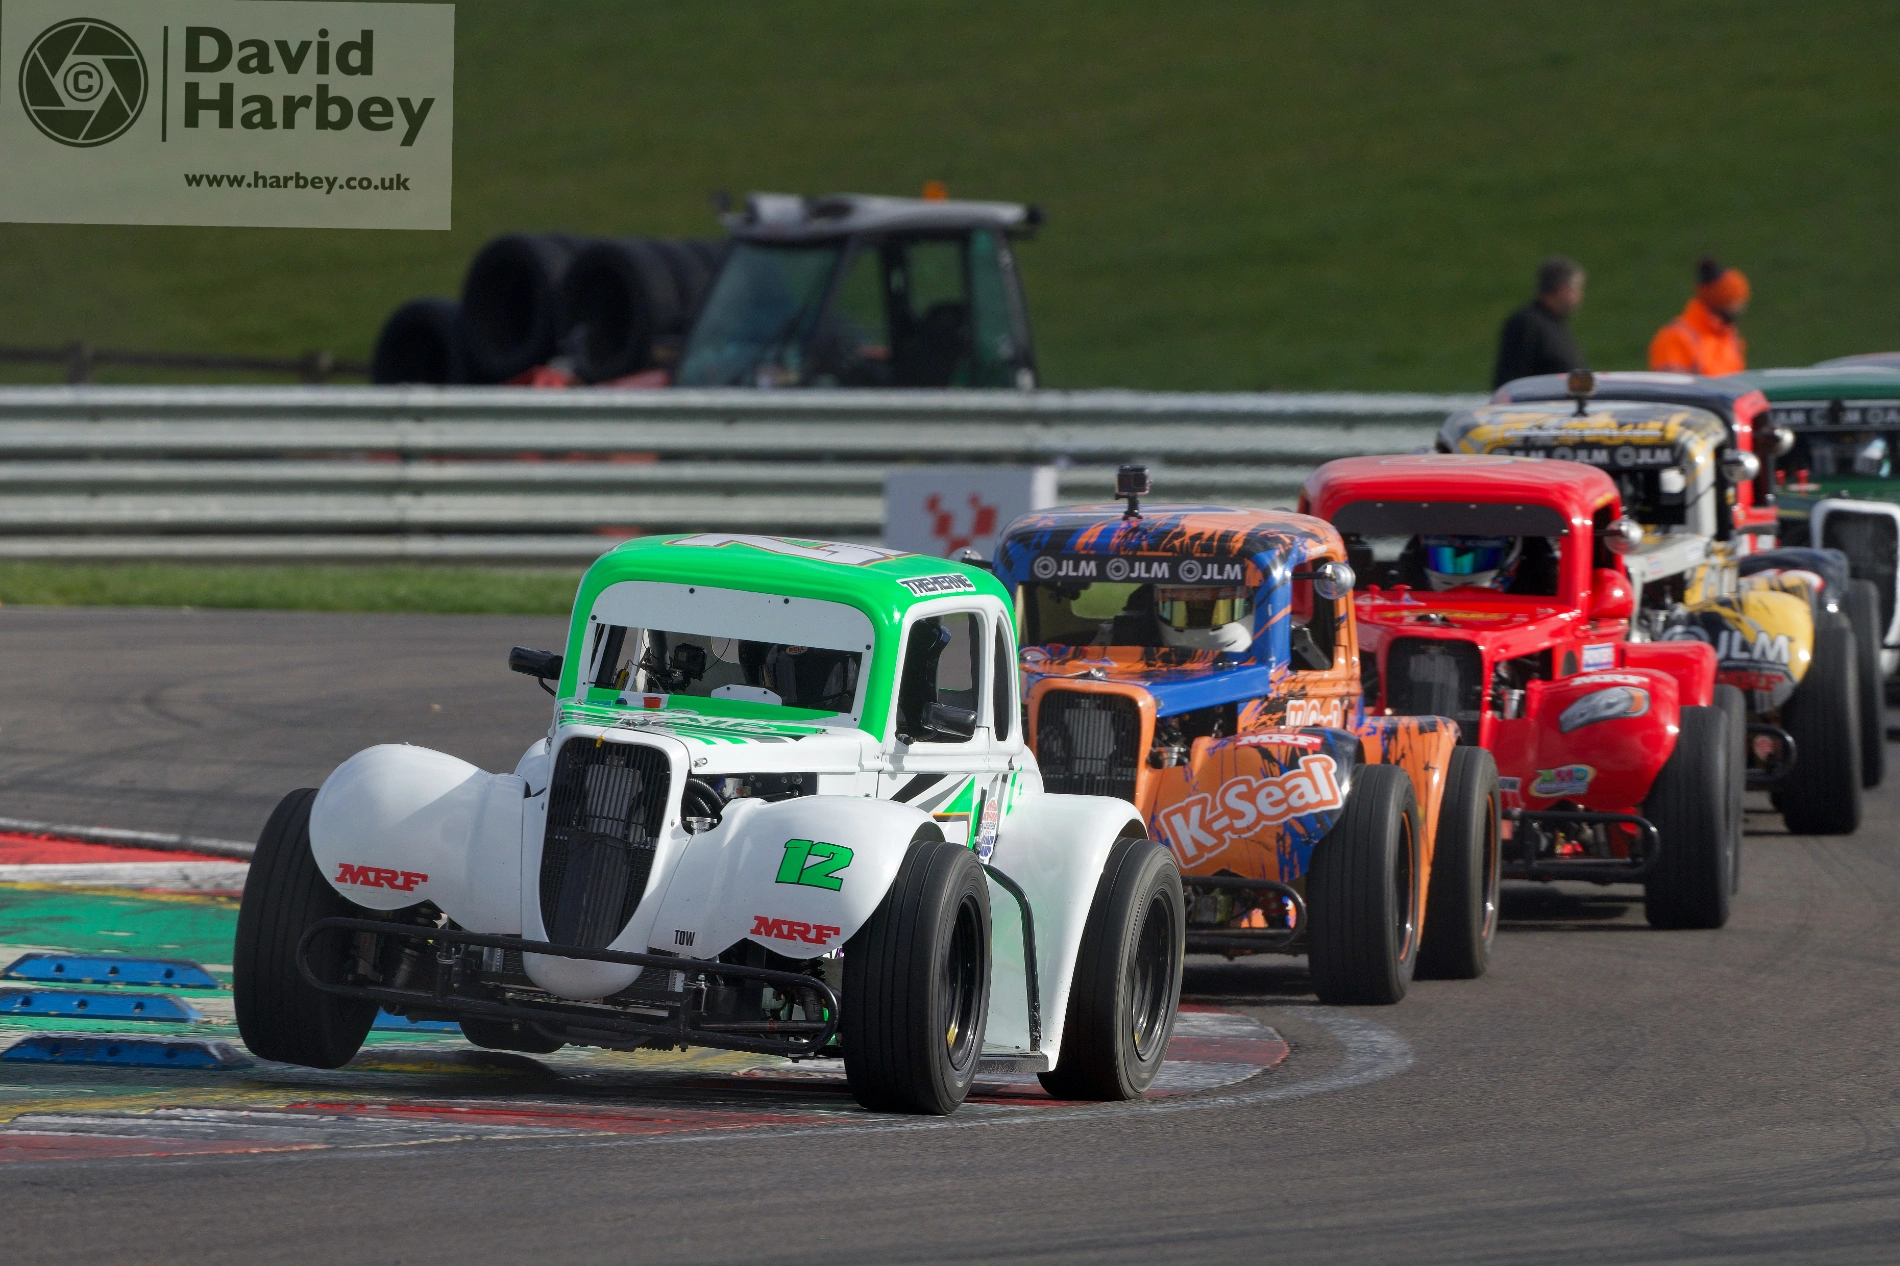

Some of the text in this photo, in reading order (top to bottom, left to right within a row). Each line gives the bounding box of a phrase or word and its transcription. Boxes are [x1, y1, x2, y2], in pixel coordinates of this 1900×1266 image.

[1636, 448, 1672, 464] JLM
[1057, 560, 1242, 580] JLM JLM JLM
[1717, 630, 1789, 664] JLM
[1237, 733, 1321, 747] MRF
[775, 838, 854, 892] 12
[334, 863, 428, 892] MRF
[674, 929, 696, 947] TOW
[750, 915, 840, 945] MRF
